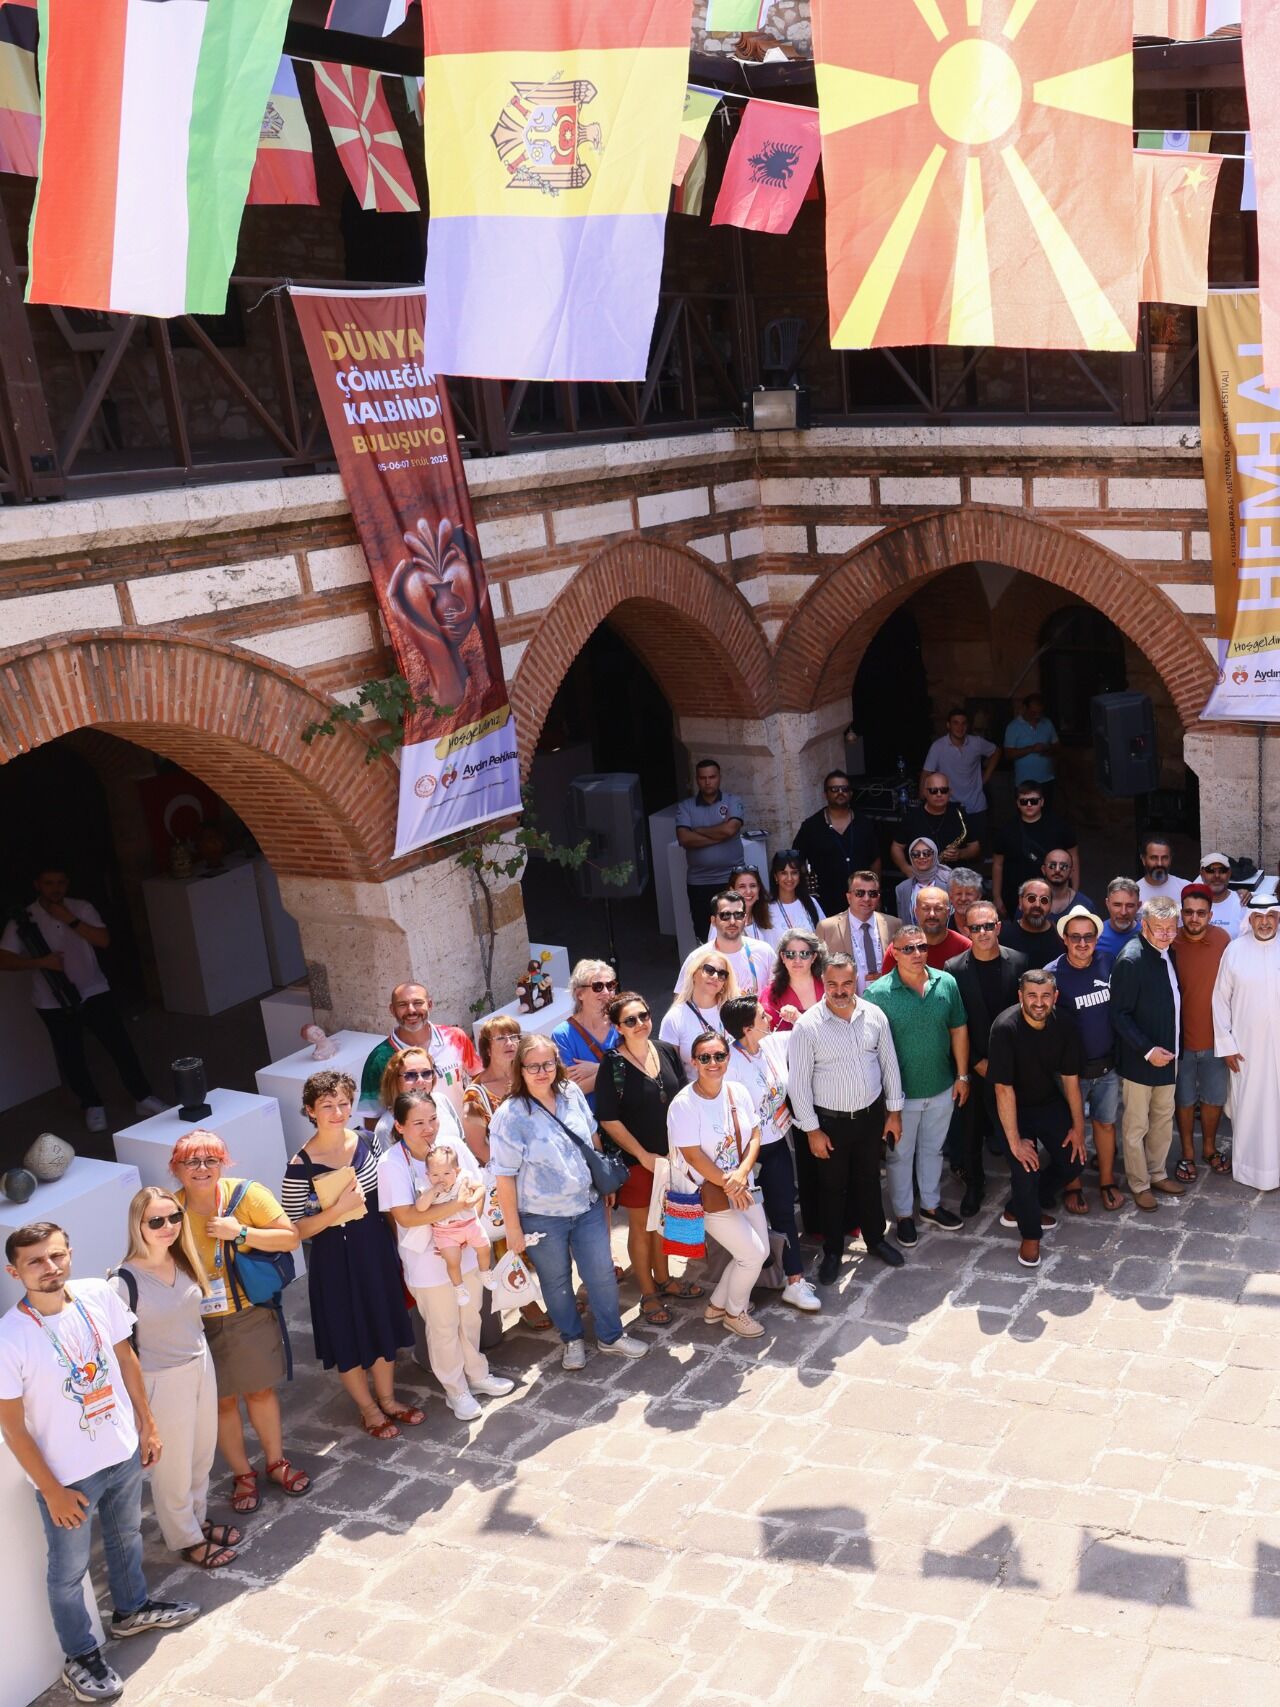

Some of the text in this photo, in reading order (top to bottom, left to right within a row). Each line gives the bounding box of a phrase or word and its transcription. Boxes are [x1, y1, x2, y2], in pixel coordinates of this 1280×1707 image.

[322, 322, 425, 361] DÜNYA
[343, 394, 442, 425] KALBİND
[352, 427, 446, 454] BULUŞUYO
[430, 454, 448, 465] 2025
[1224, 450, 1233, 494] MENEMEN
[1254, 669, 1280, 680] Aydın
[1074, 988, 1111, 1010] PUMA
